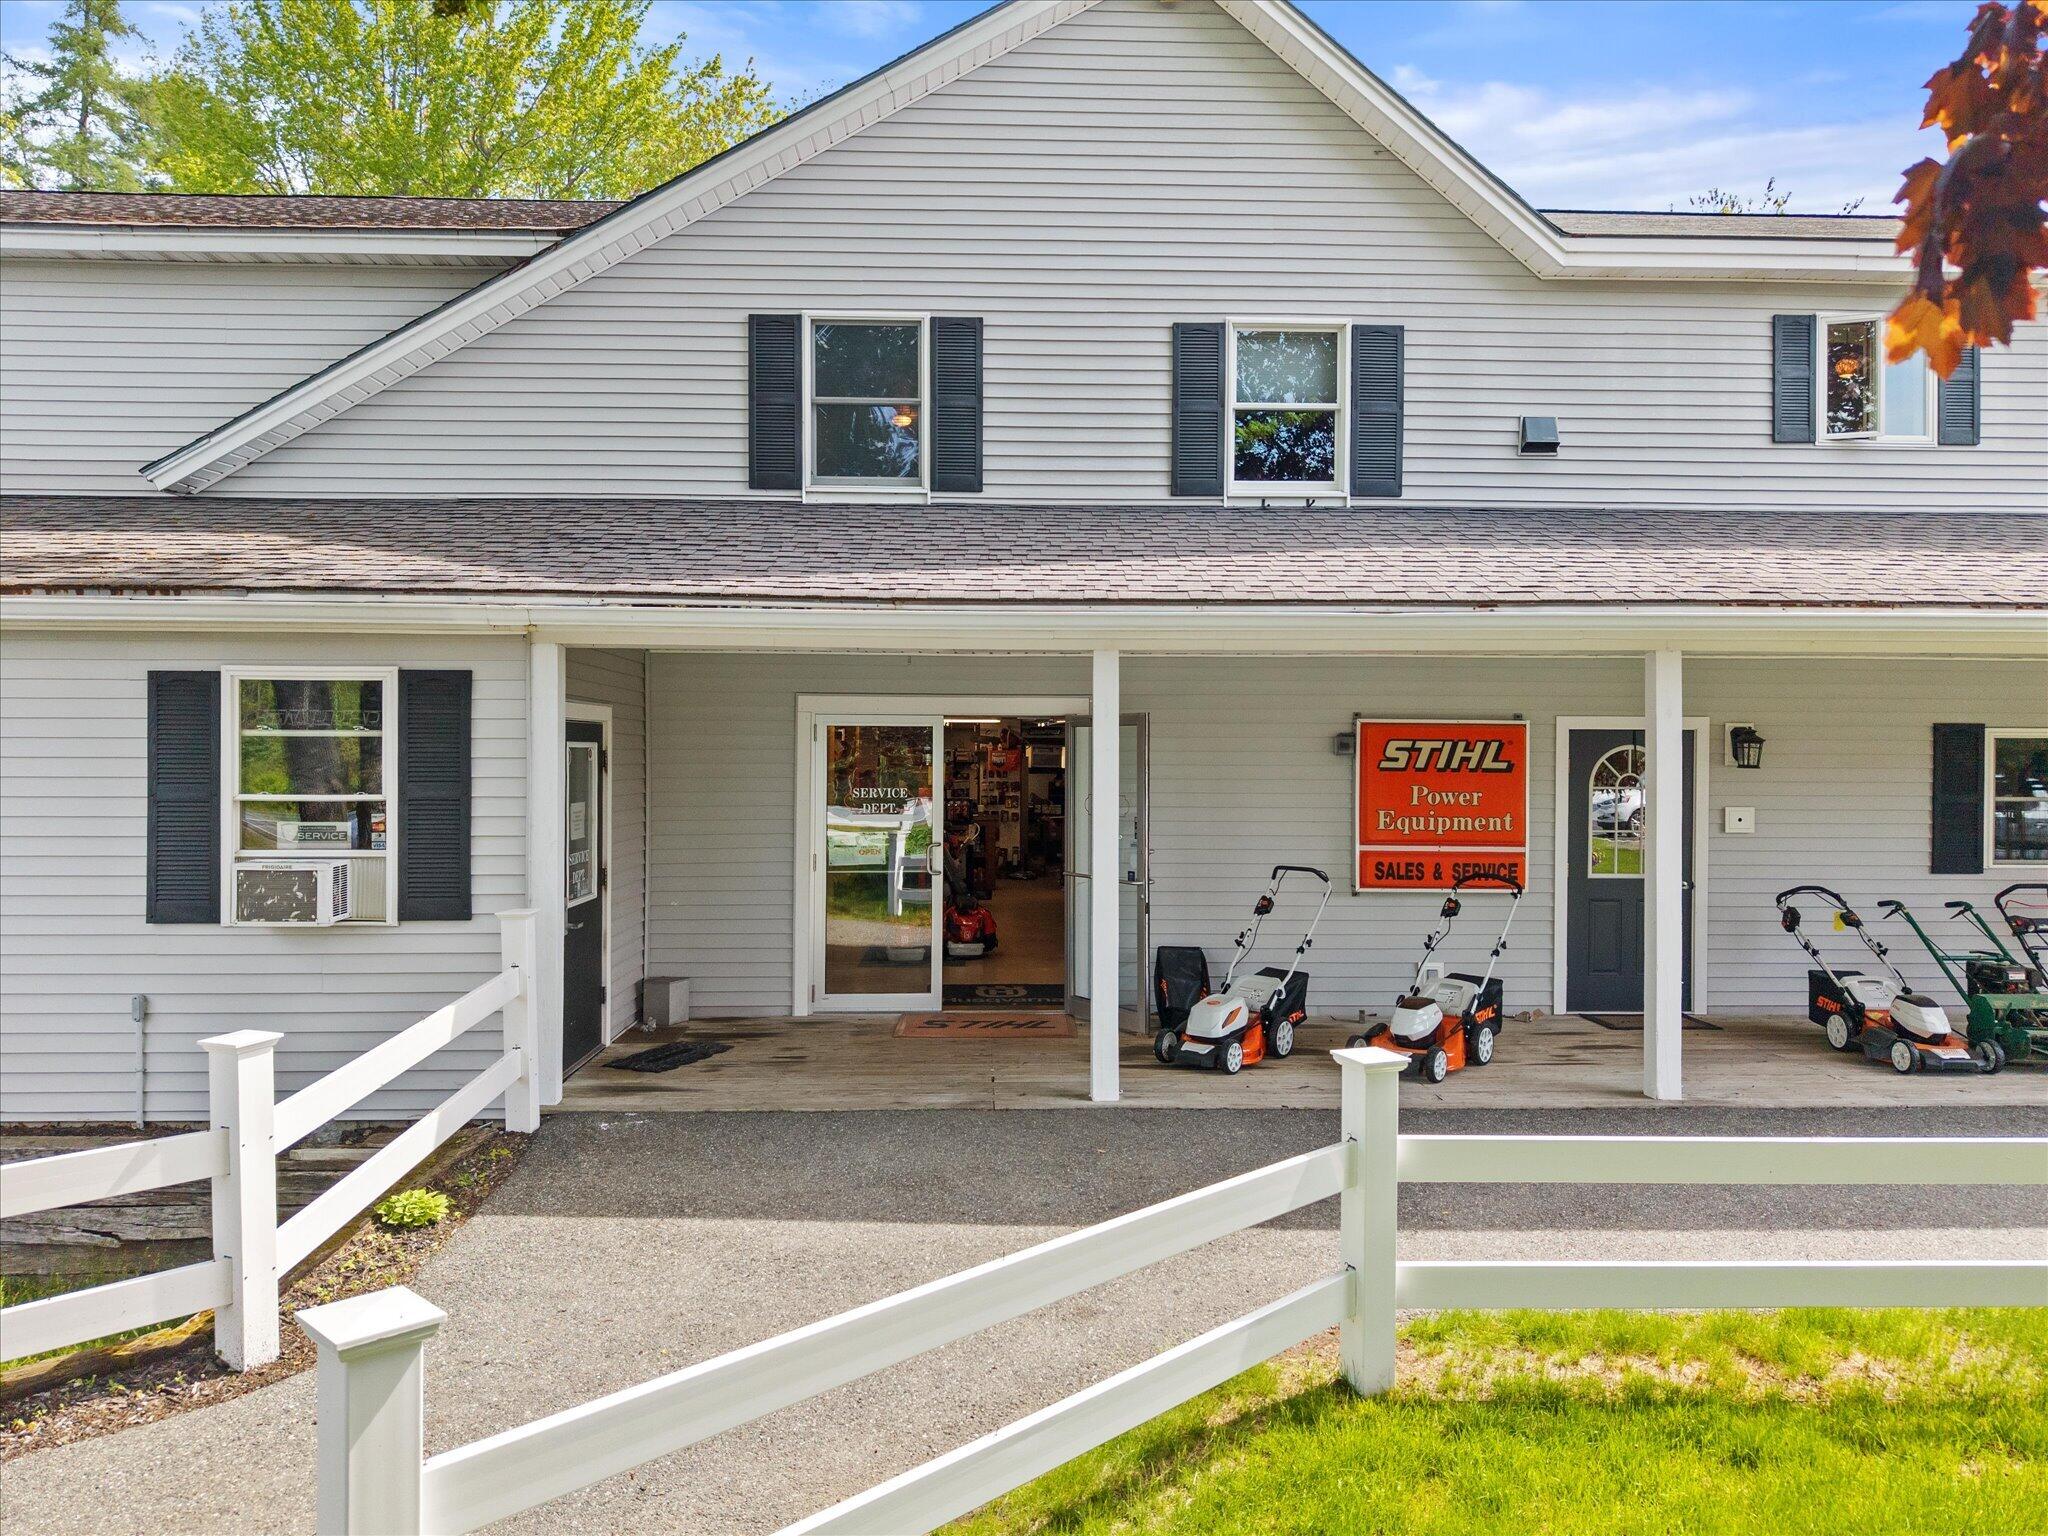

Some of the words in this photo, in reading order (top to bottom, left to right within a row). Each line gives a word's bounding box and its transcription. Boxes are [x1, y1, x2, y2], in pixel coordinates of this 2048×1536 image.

[1377, 738, 1515, 773] STIHL
[852, 787, 908, 799] SERVICE
[1410, 785, 1483, 806] Power
[862, 803, 897, 814] DEPT.
[1377, 810, 1514, 835] Equipment
[297, 832, 347, 840] SERVICE
[859, 848, 881, 856] OPEN
[1374, 861, 1425, 881] SALES
[1433, 862, 1443, 881] &
[1452, 862, 1519, 881] SERVICE
[918, 1020, 1056, 1029] STIHL
